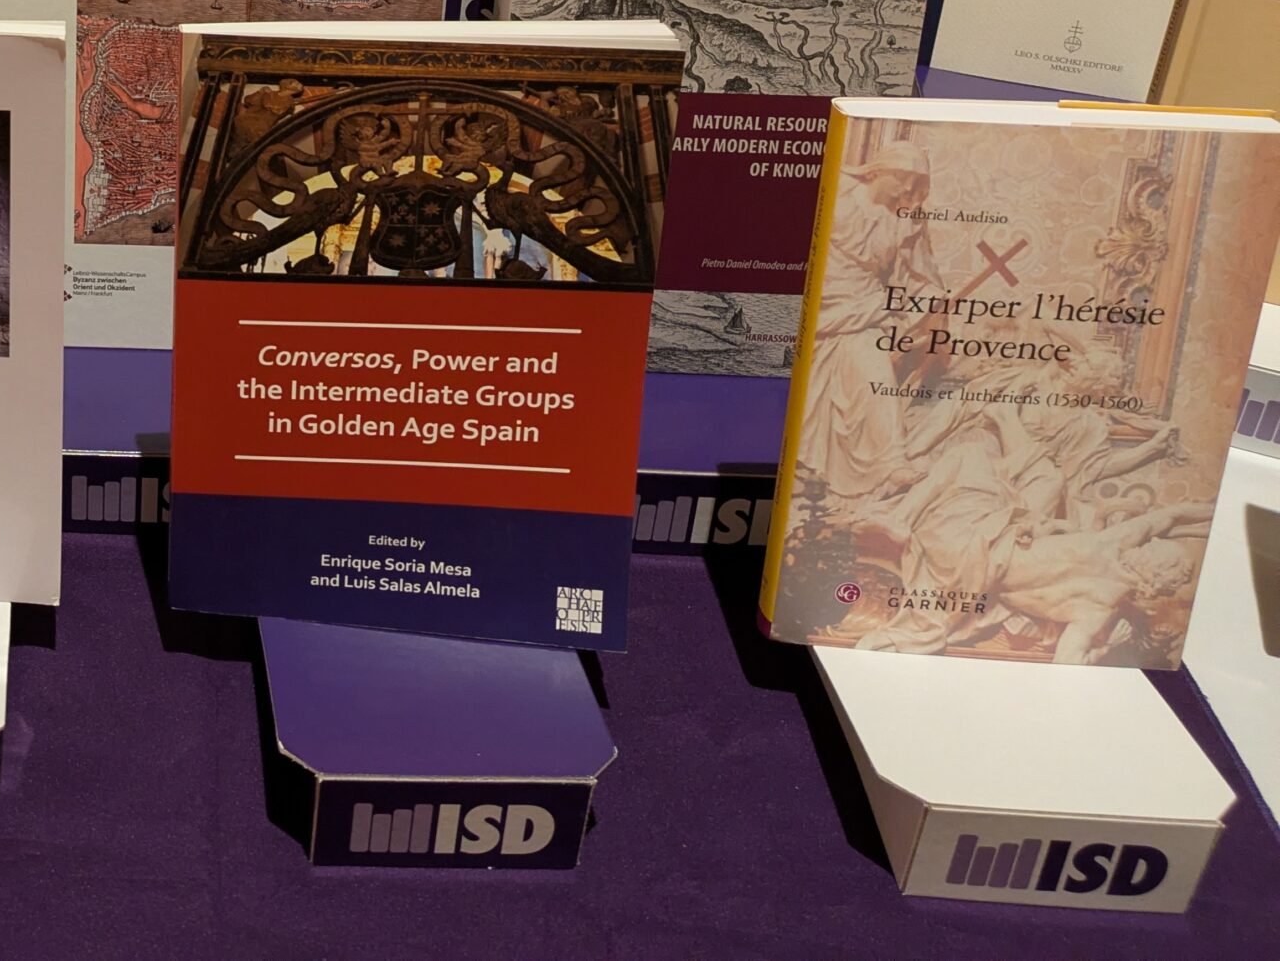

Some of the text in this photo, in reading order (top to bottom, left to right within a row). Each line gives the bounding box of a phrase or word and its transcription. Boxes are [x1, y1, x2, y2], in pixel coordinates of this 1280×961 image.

[1015, 50, 1031, 58] LEO
[1043, 54, 1081, 67] OLSCHKI
[1083, 60, 1123, 72] EDITORE
[693, 115, 762, 131] NATURAL
[713, 140, 779, 154] MODERN
[750, 163, 768, 176] OF
[896, 207, 1008, 224] Gabriel Audisio
[702, 258, 803, 270] Pietro Daniel Omodeo and
[73, 276, 95, 284] Byzanz
[882, 285, 1020, 323] Extirper
[875, 327, 1071, 361] de Provence
[258, 345, 557, 375] Conversos, Power and
[237, 378, 574, 414] the Intermediate Groups
[268, 412, 539, 446] in Golden Age Spain
[890, 587, 988, 601] CLASSIQUES
[888, 598, 986, 614] GARNIER
[434, 803, 555, 855] ISD
[1035, 840, 1168, 896] ISD
